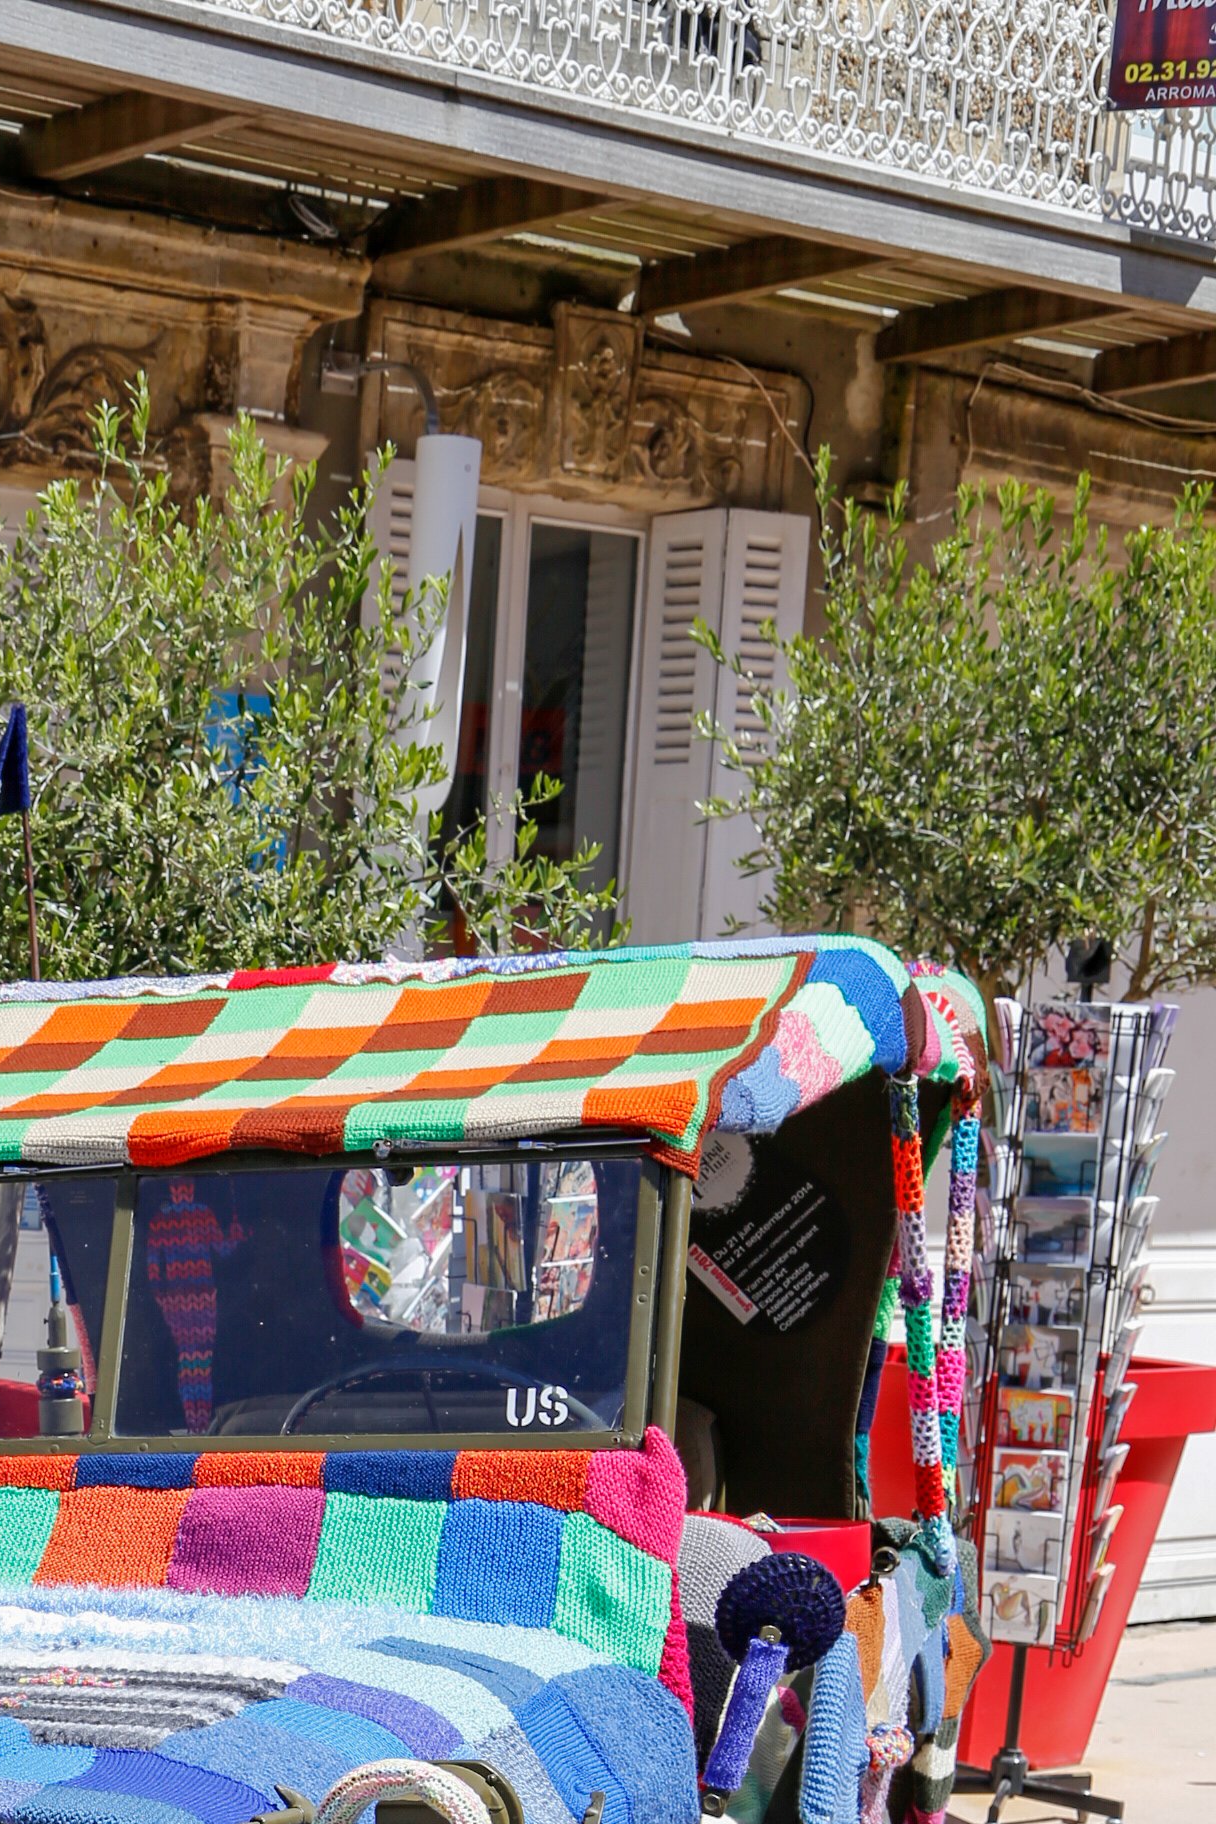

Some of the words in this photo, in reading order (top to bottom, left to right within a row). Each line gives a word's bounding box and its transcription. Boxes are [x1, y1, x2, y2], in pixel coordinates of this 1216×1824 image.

[713, 1247, 725, 1261] Du
[727, 1235, 737, 1248] 21
[737, 1221, 755, 1242] juin
[722, 1255, 735, 1270] au
[734, 1245, 746, 1258] 21
[745, 1203, 792, 1248] septembre
[790, 1182, 814, 1205] 2014
[689, 1246, 713, 1272] 2014
[762, 1246, 798, 1279] Bombing
[795, 1224, 820, 1252] géant
[759, 1286, 784, 1310] Expos
[782, 1261, 810, 1290] photos
[774, 1267, 789, 1284] Art
[505, 1385, 570, 1428] US
